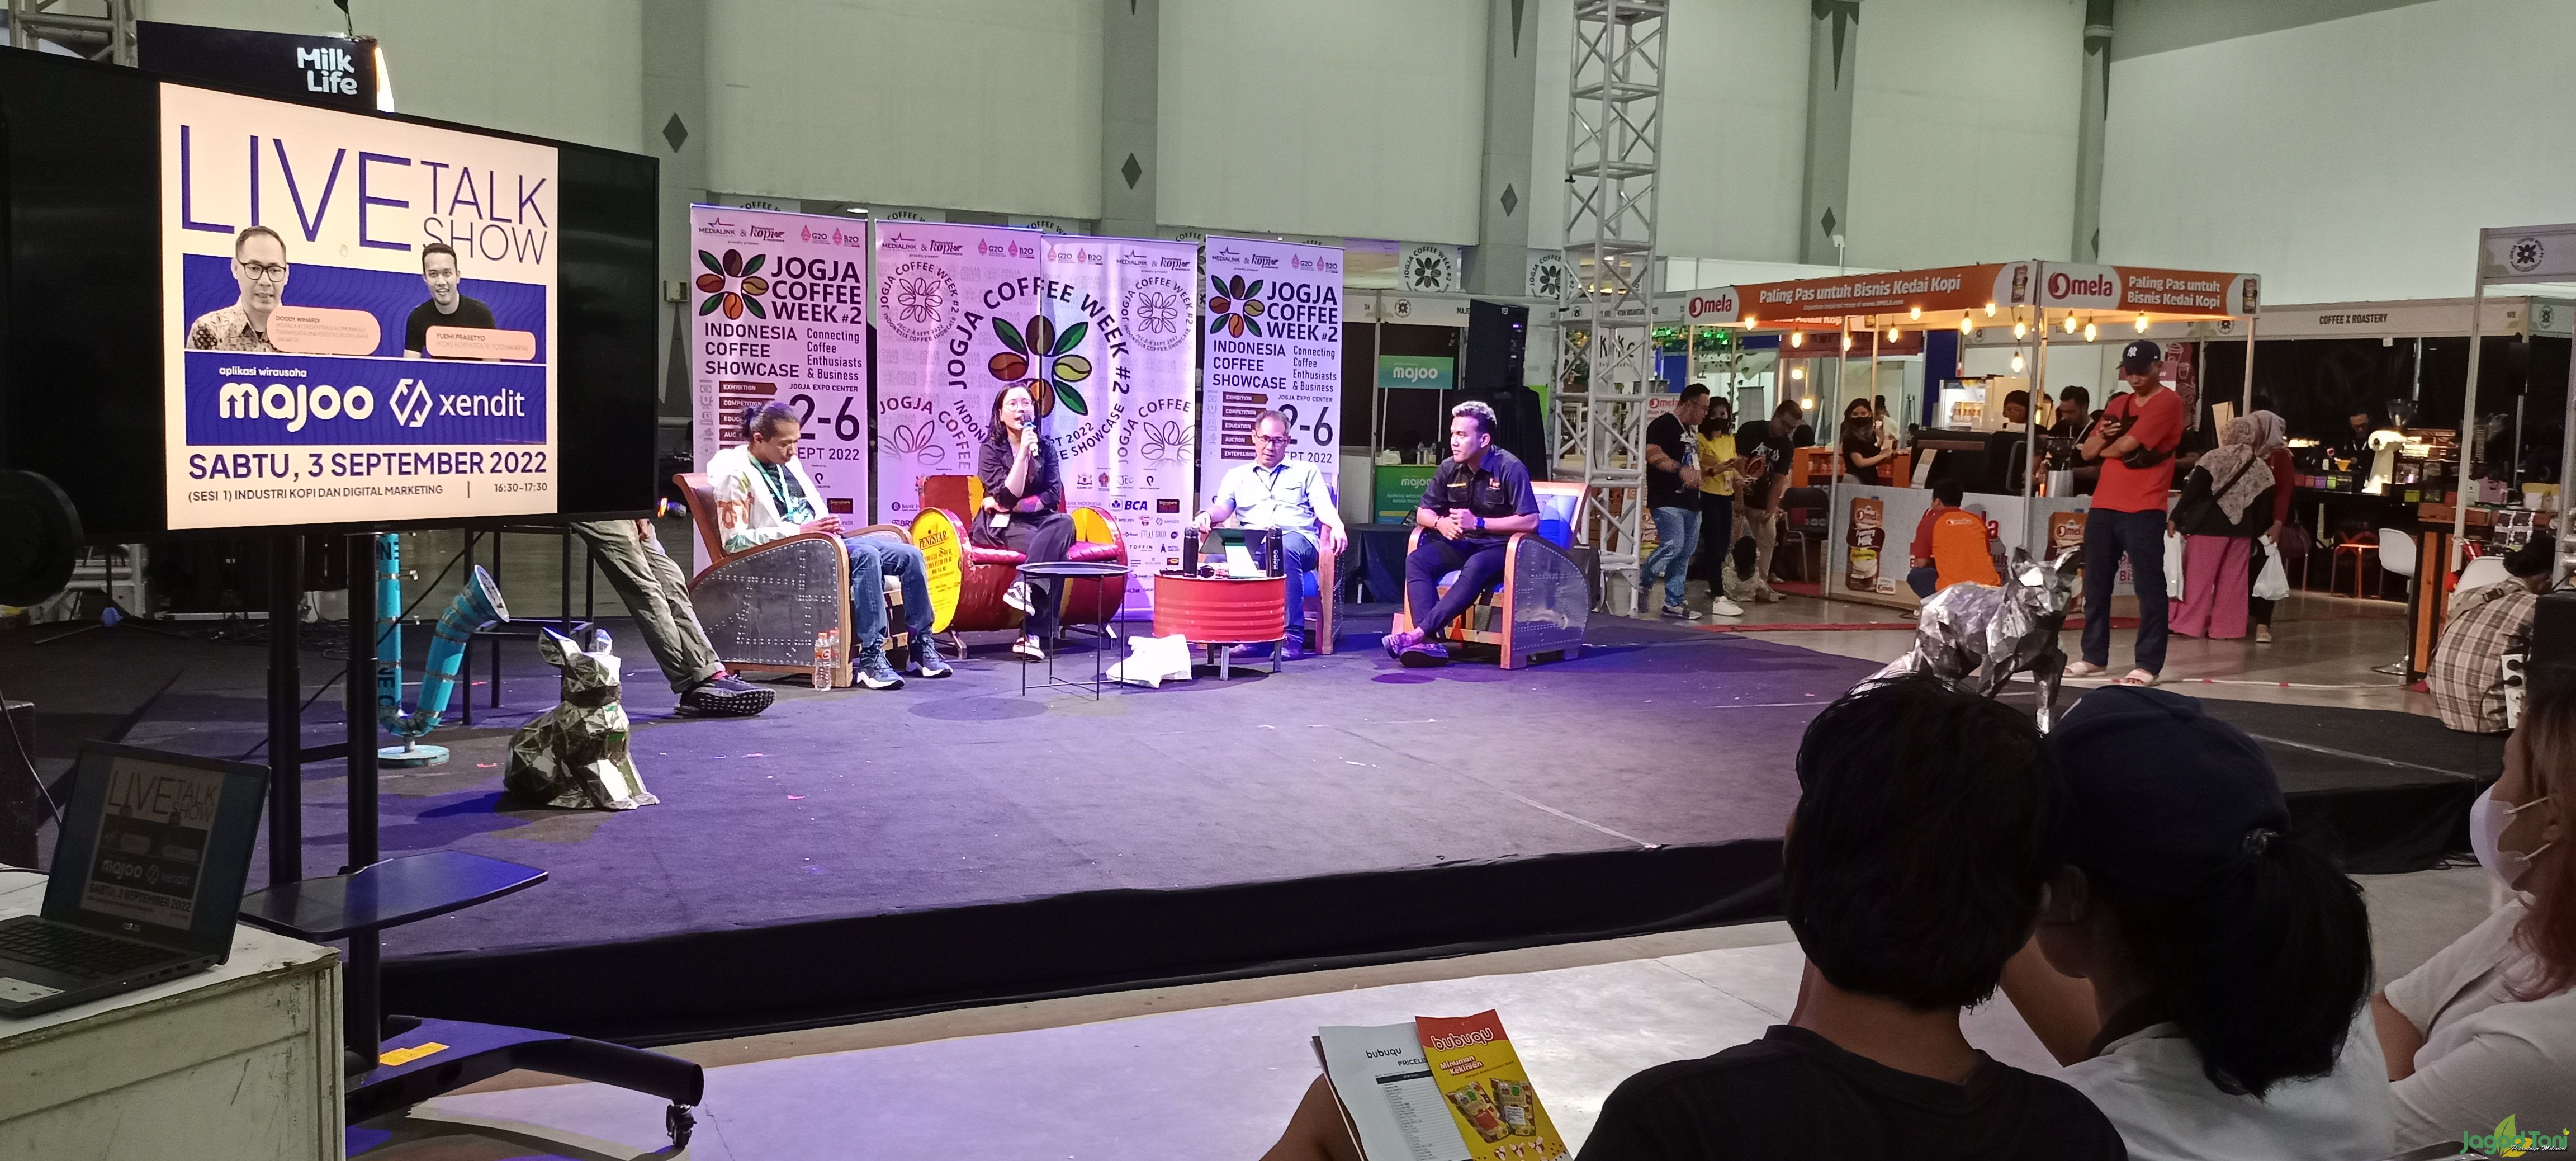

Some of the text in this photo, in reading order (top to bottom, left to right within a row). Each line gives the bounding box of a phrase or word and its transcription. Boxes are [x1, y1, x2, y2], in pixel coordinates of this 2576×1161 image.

[297, 47, 355, 72] Milk
[307, 71, 357, 95] Life
[181, 125, 411, 251] LIVE
[420, 161, 547, 227] TALK
[422, 218, 548, 265] SHOW
[771, 256, 861, 284] JOGJA
[1404, 257, 1414, 279] JOGJA
[1414, 246, 1437, 257] COFFEE
[771, 280, 862, 305] COFFEE
[880, 276, 896, 309] JOGJA
[896, 261, 935, 276] COFFEE
[937, 268, 958, 297] WEEK
[1267, 281, 1337, 305] JOGJA
[1759, 274, 1961, 304] Paling Pas untuk Bisnis Kedai Kopi
[2048, 272, 2113, 300] Omela
[2128, 276, 2220, 292] Paling Pas untuk
[1121, 290, 1135, 321] JOGJA
[1135, 277, 1171, 290] COFFEE
[1173, 283, 1193, 310] WEEK
[1688, 294, 1732, 318] Omela
[2128, 291, 2220, 309] Bisnis Kedai Kopi
[771, 301, 862, 324] WEEK #2
[1267, 303, 1338, 324] COFFEE
[2319, 313, 2388, 325] COFFEE X ROASTERY
[705, 323, 798, 341] INDONESIA
[807, 328, 860, 344] Connecting
[947, 277, 1131, 394] JOGJA COFFEE WEEK #2
[1267, 321, 1338, 342] WEEK #2
[705, 342, 770, 358] COFFEE
[807, 342, 837, 353] Coffee
[1213, 340, 1286, 357] INDONESIA
[1294, 346, 1336, 360] Connecting
[705, 361, 799, 378] SHOWCASE
[807, 355, 863, 369] Enthusiasts
[1213, 357, 1264, 371] COFFEE
[1293, 357, 1317, 368] Coffee
[219, 366, 307, 378] aplikasi wirausaha
[807, 368, 859, 381] & Business
[1293, 369, 1337, 381] Enthusiasts
[1393, 367, 1438, 383] majoo
[1213, 374, 1286, 389] SHOWCASE
[1292, 381, 1333, 392] & Business
[220, 383, 525, 432] majoo xendit
[880, 395, 933, 414] JOGJA
[1139, 398, 1191, 418] COFFEE
[1066, 422, 1094, 443] 2022
[1073, 403, 1125, 457] SHOWCASE
[828, 448, 860, 461] 2022
[1308, 452, 1332, 464] 2022
[188, 451, 547, 482] SABTU, 3 SEPTEMBER 2022
[188, 490, 219, 503] (SESI
[223, 489, 232, 502] 1)
[235, 489, 287, 500] INDUSTRI
[290, 488, 316, 499] KOPI
[319, 487, 341, 498] DAN
[343, 485, 383, 497] DIGITAL
[385, 484, 443, 496] MARKETING
[1124, 501, 1148, 511] BCA
[1431, 1027, 1494, 1051] bubuqu
[1366, 1047, 1401, 1059] bubuqu
[1398, 1057, 1428, 1066] PRICELIS
[1440, 1055, 1475, 1070] Minuman
[1449, 1061, 1484, 1075] Kekinian
